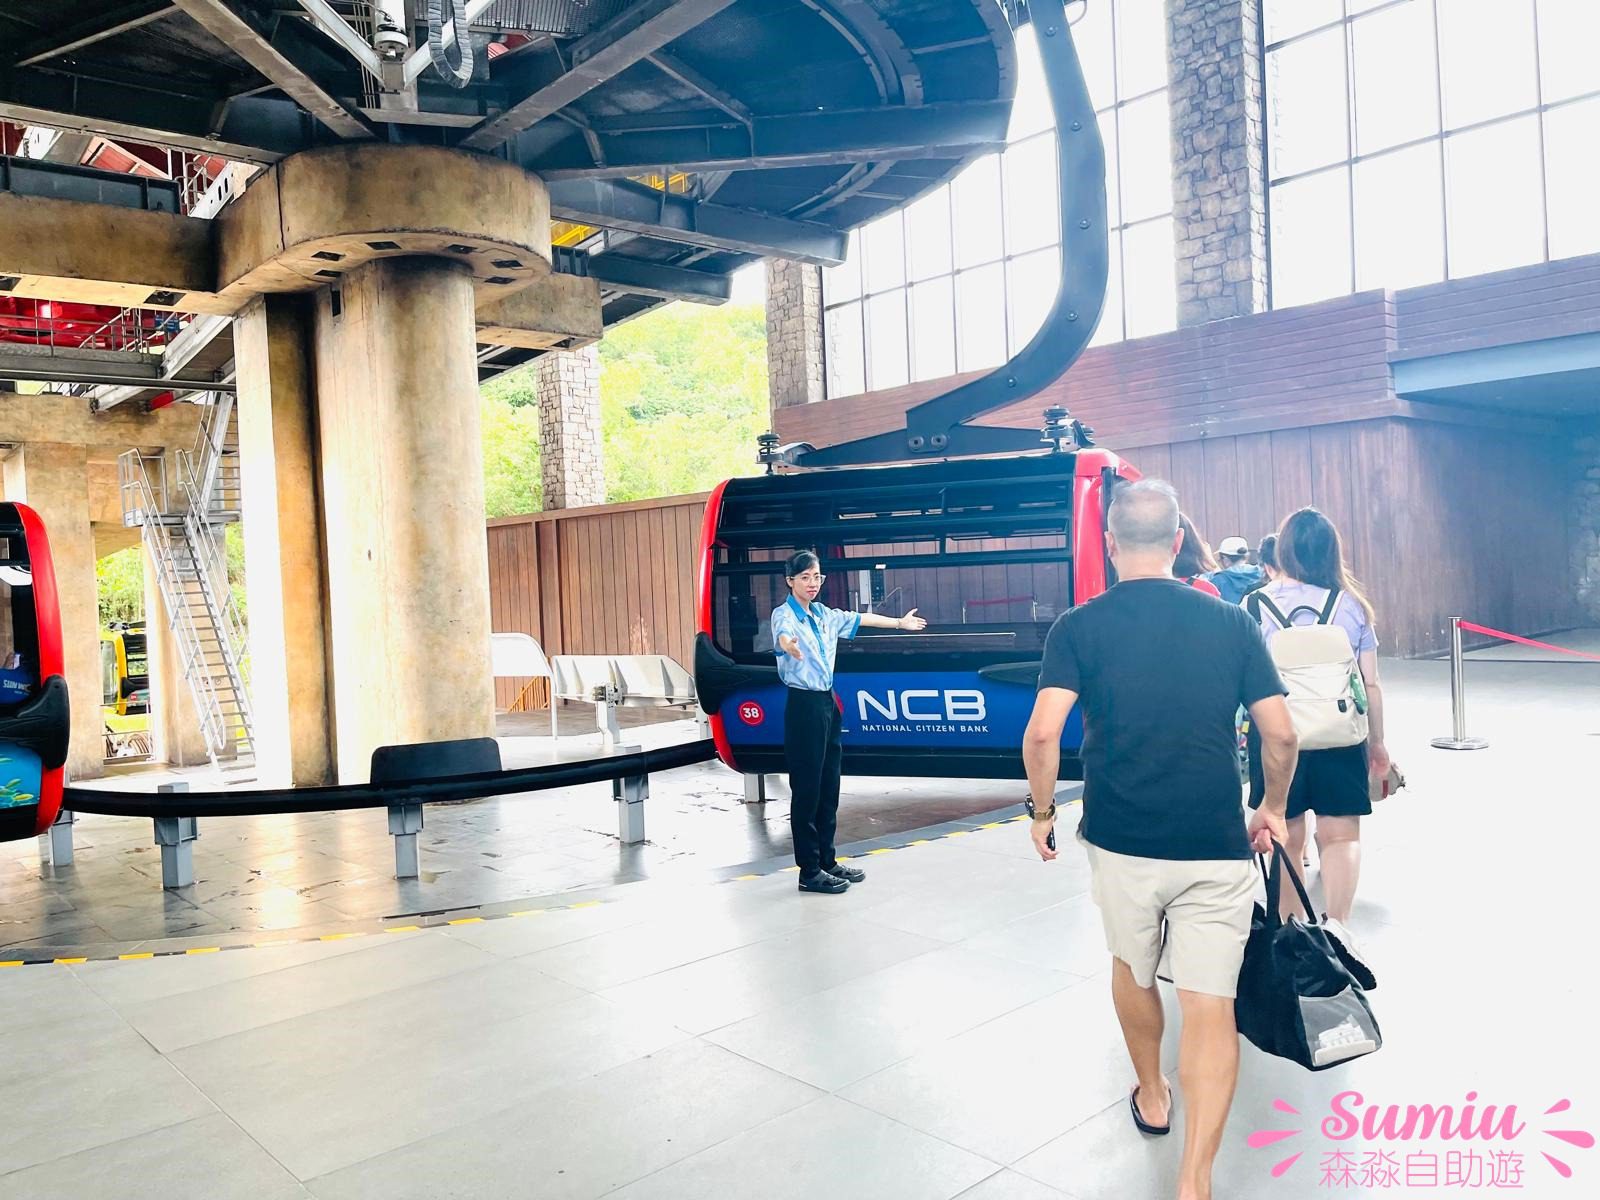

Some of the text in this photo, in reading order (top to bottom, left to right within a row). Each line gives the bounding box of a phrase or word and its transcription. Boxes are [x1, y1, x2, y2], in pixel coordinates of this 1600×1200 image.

[856, 689, 987, 721] NCB
[742, 707, 760, 719] 38
[862, 724, 989, 733] NATIONAL CITIZEN BANK
